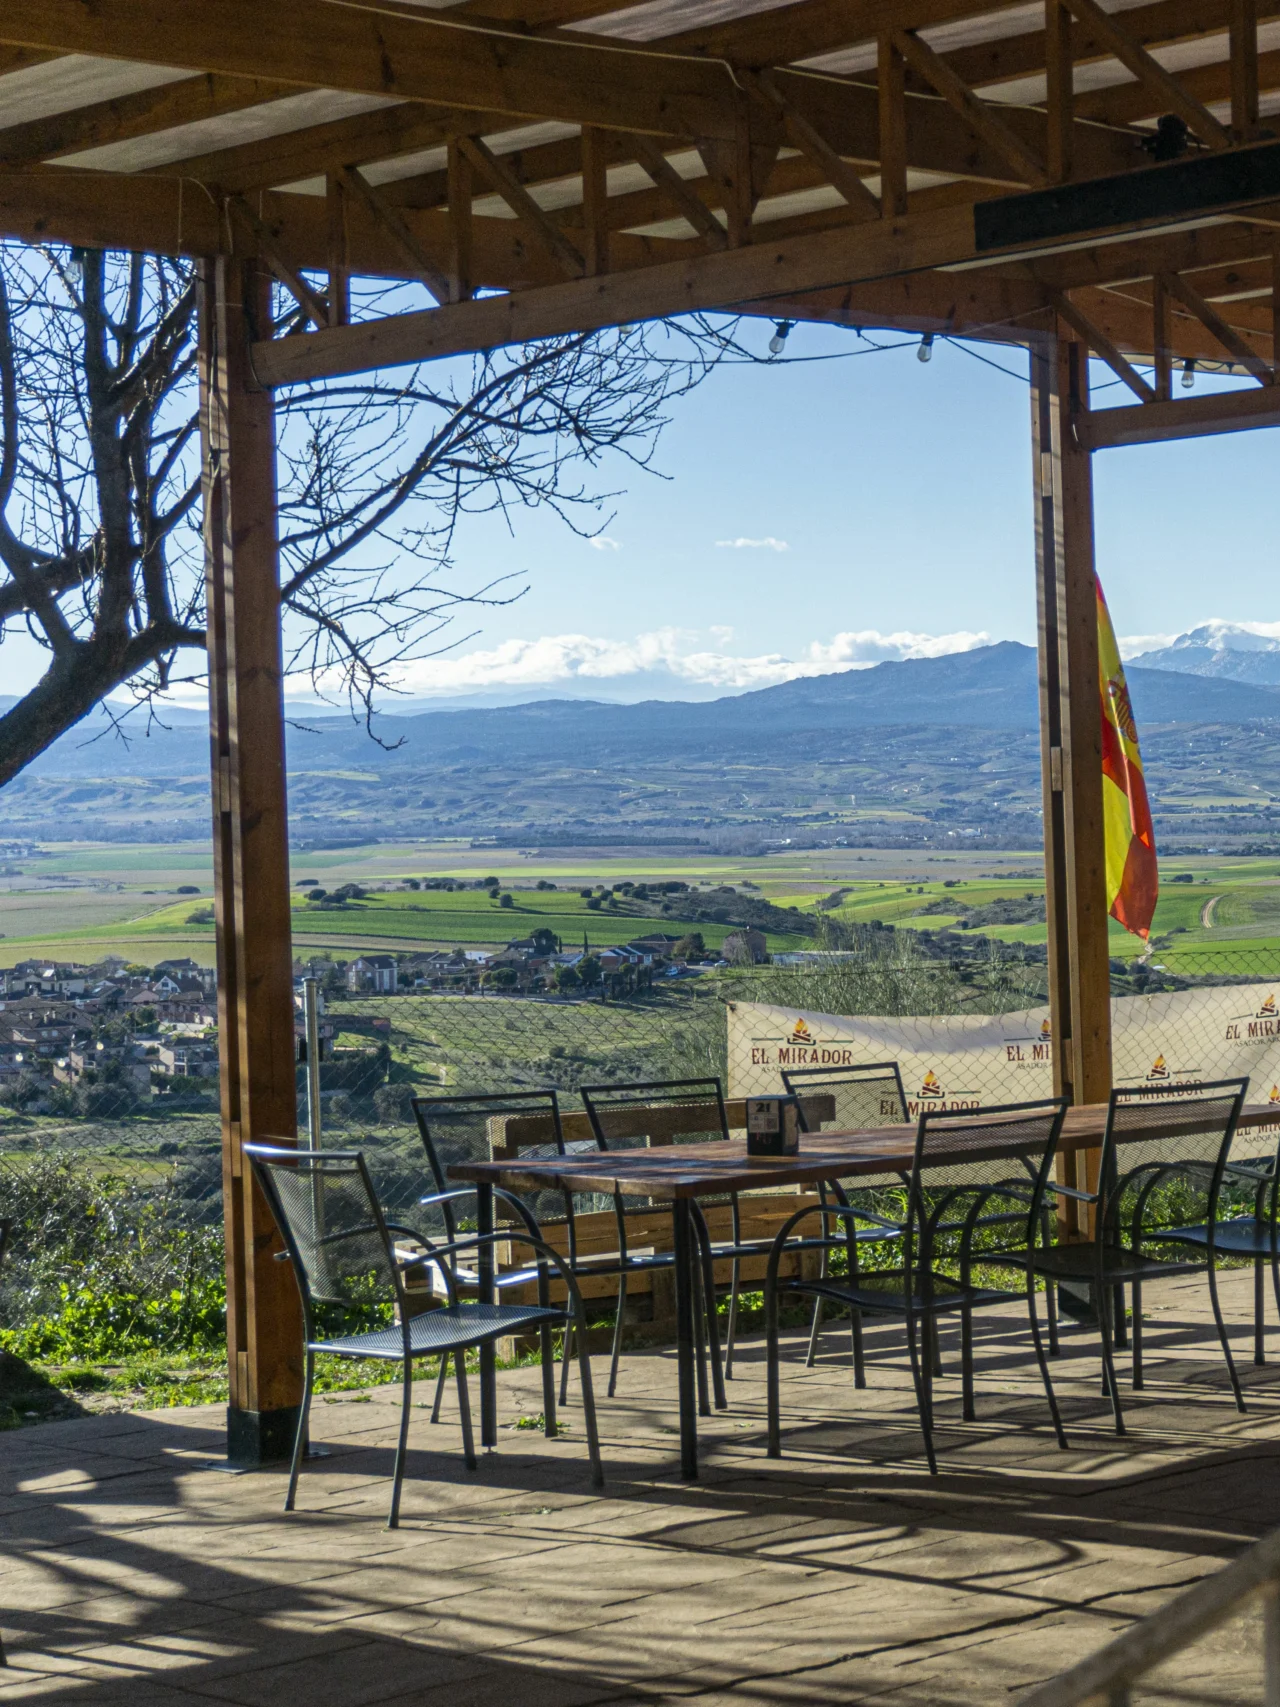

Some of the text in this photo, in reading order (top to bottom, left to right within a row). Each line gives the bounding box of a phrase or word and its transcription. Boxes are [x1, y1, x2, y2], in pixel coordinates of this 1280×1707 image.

[1225, 1024, 1241, 1040] EL
[751, 1047, 853, 1065] EL MIRADOR
[1007, 1045, 1025, 1062] EL
[879, 1100, 899, 1117] EL
